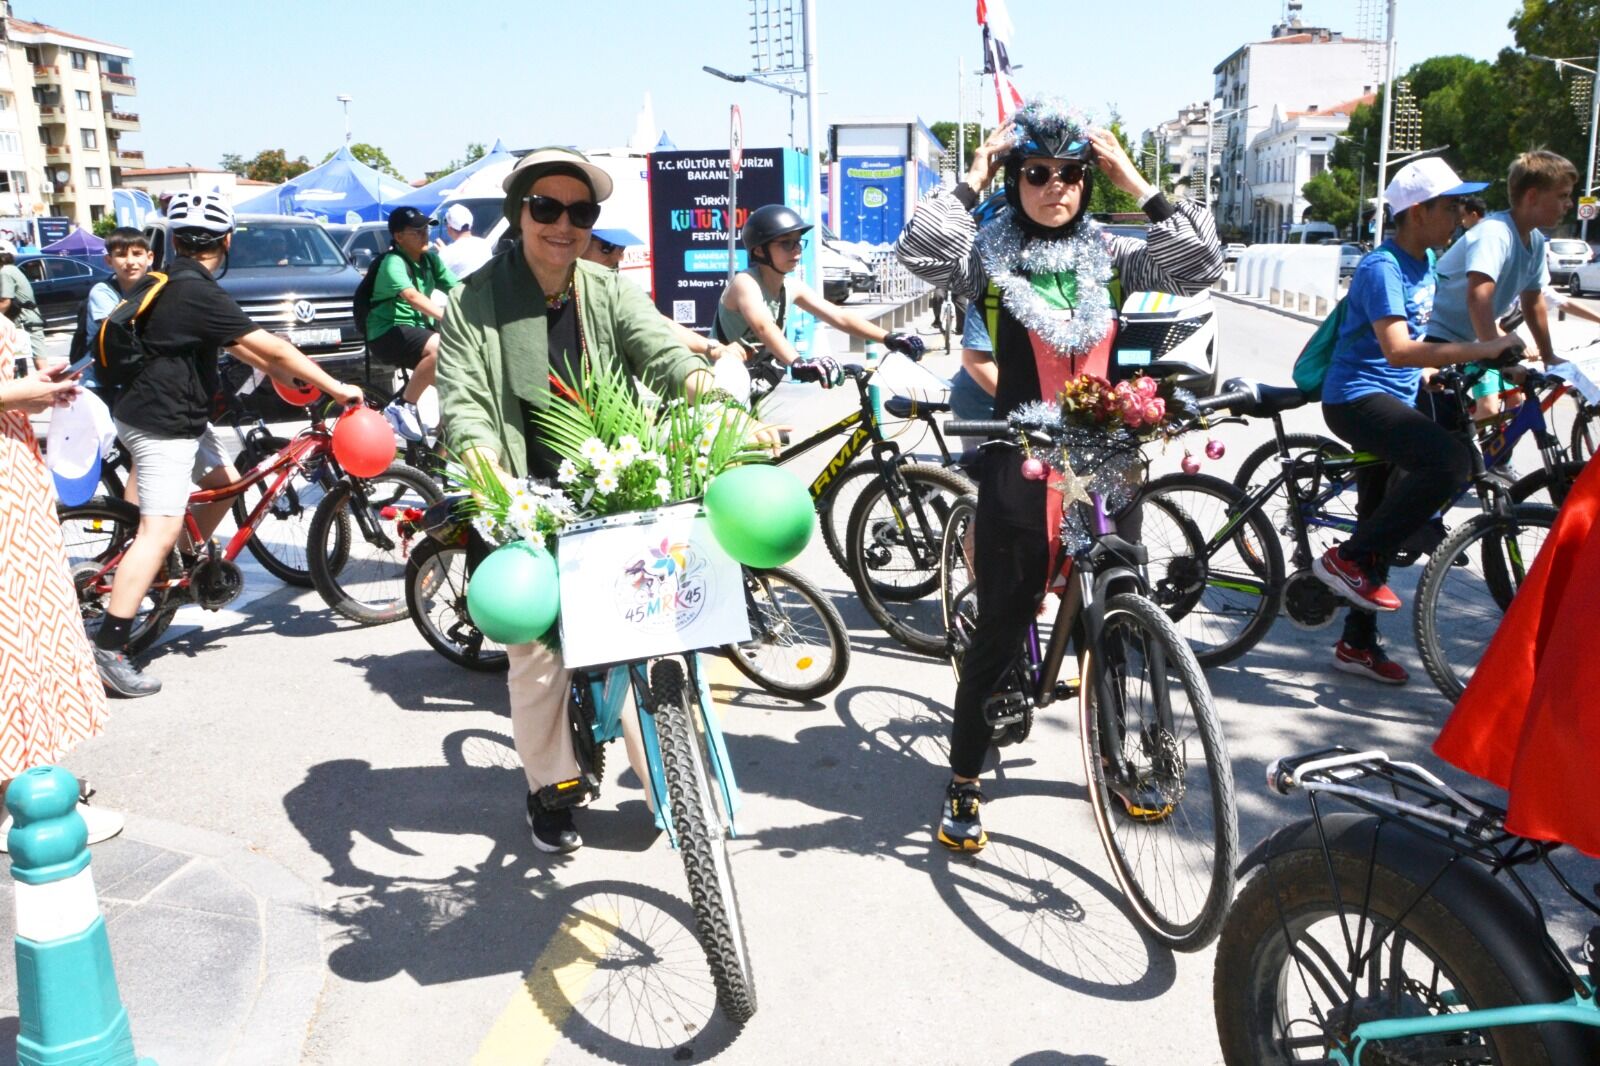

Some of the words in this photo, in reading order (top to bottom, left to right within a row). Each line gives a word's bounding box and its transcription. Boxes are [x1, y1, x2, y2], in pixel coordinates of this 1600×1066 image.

[657, 160, 676, 170] T.C.
[676, 157, 717, 170] KÜLTÜR
[718, 159, 731, 169] VE
[739, 156, 774, 168] URİZM
[687, 171, 743, 180] BAKANLI
[694, 195, 738, 206] TÜRKİY
[671, 208, 722, 232] KÜLTÜR
[722, 208, 755, 230] YOL
[691, 230, 742, 241] FESTİVİ
[677, 280, 688, 288] 30
[689, 280, 714, 289] Mayıs
[812, 427, 869, 499] RMA
